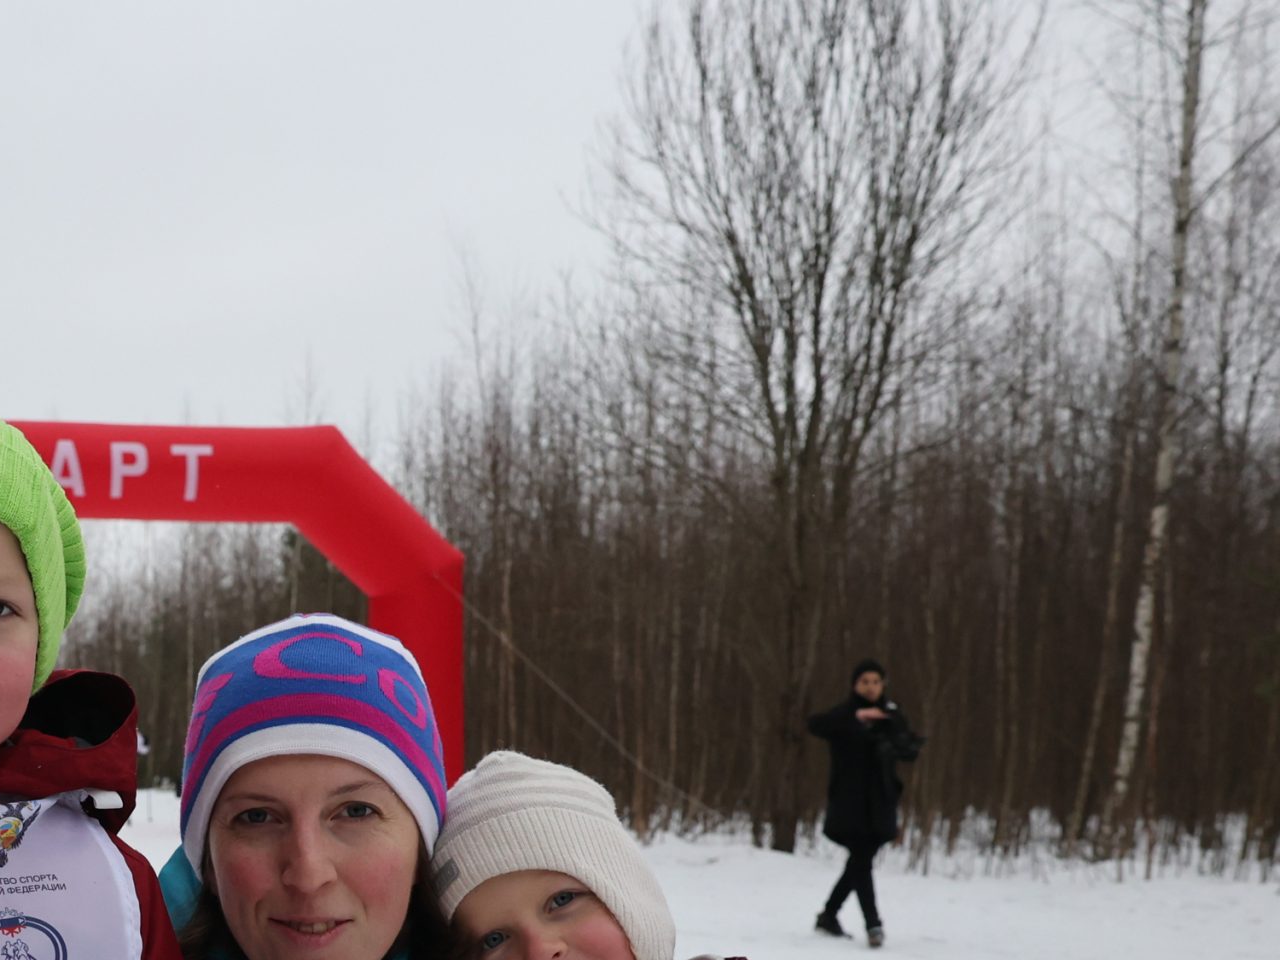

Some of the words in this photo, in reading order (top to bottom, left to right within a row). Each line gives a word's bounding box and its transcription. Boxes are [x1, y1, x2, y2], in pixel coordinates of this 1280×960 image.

[51, 439, 214, 501] АРТ
[20, 874, 58, 884] СПОРТА
[7, 883, 67, 894] ФЕДЕРАЦИИ
